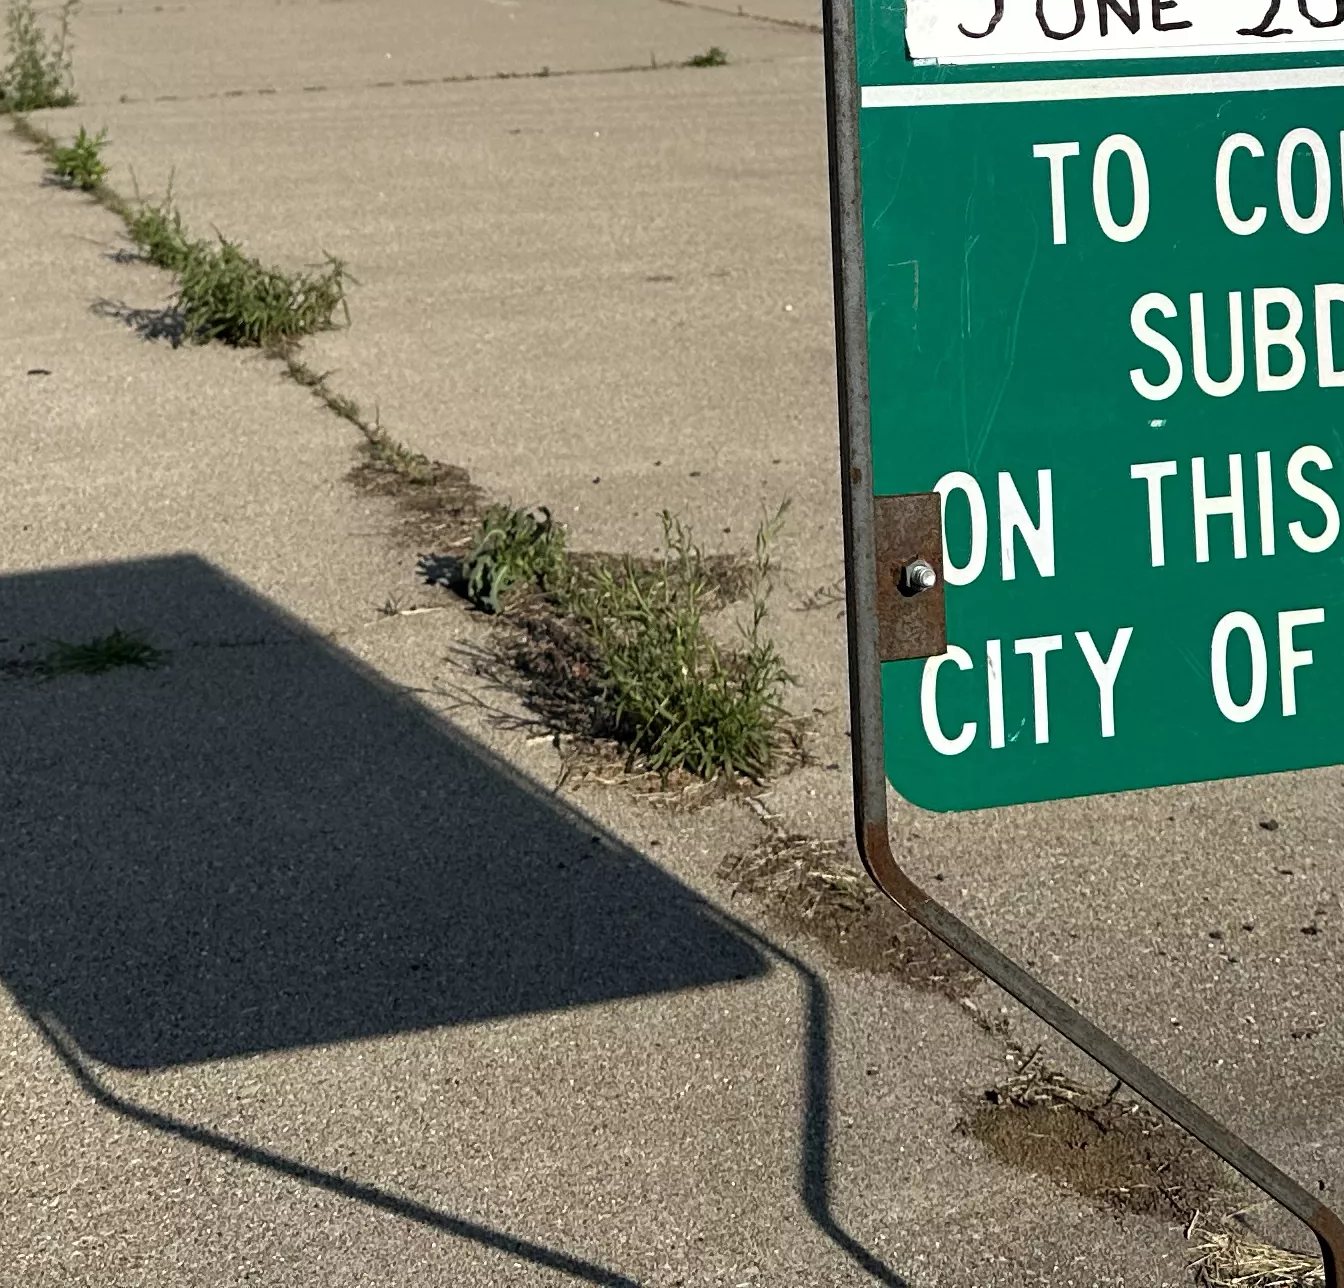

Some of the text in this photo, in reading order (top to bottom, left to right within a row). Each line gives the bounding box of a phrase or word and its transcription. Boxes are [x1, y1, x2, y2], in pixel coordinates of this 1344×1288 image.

[1033, 133, 1150, 245] TO
[932, 468, 1055, 586] ON
[1130, 445, 1341, 568] THIS
[920, 626, 1134, 756] CITY
[1211, 607, 1325, 723] OF
